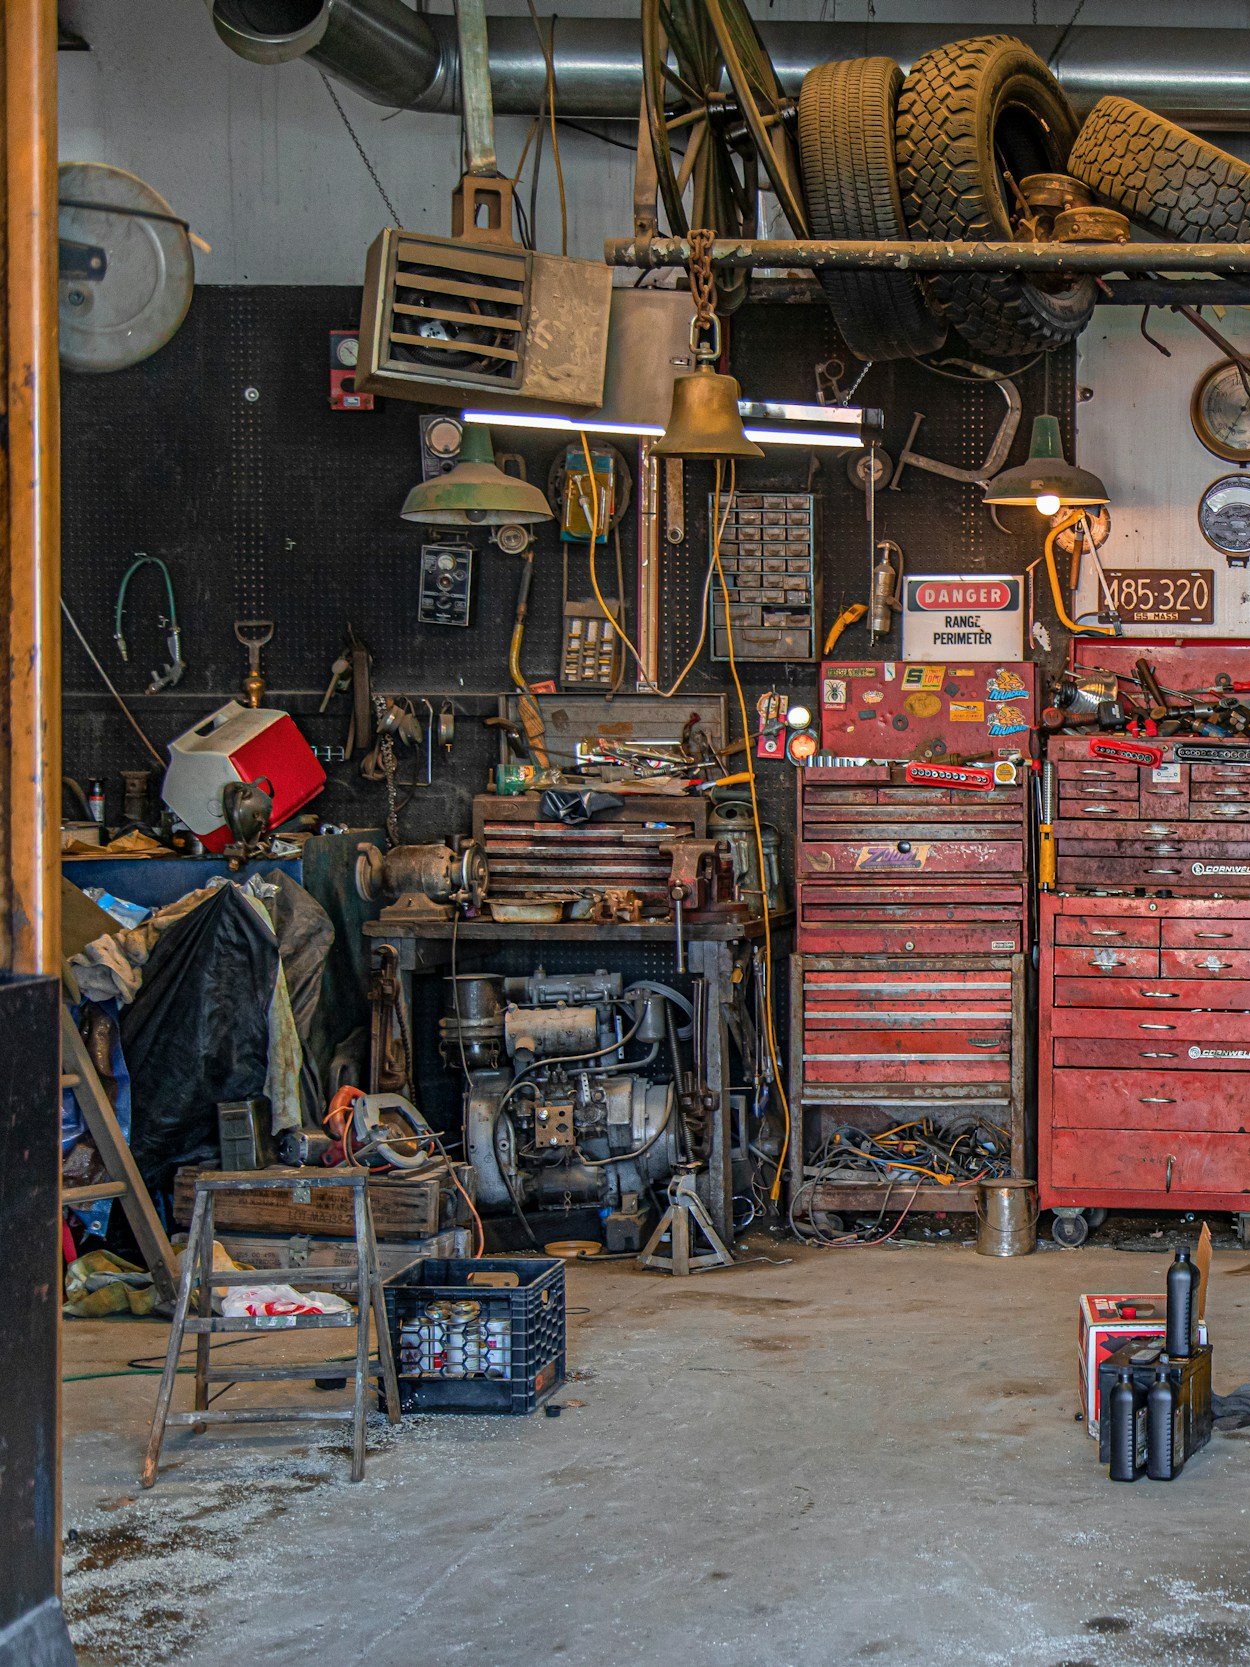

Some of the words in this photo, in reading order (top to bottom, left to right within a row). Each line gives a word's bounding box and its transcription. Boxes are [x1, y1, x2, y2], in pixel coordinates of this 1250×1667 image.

[924, 588, 1002, 604] DANGER
[945, 615, 981, 628] RANGE
[933, 632, 992, 645] PERIMETER
